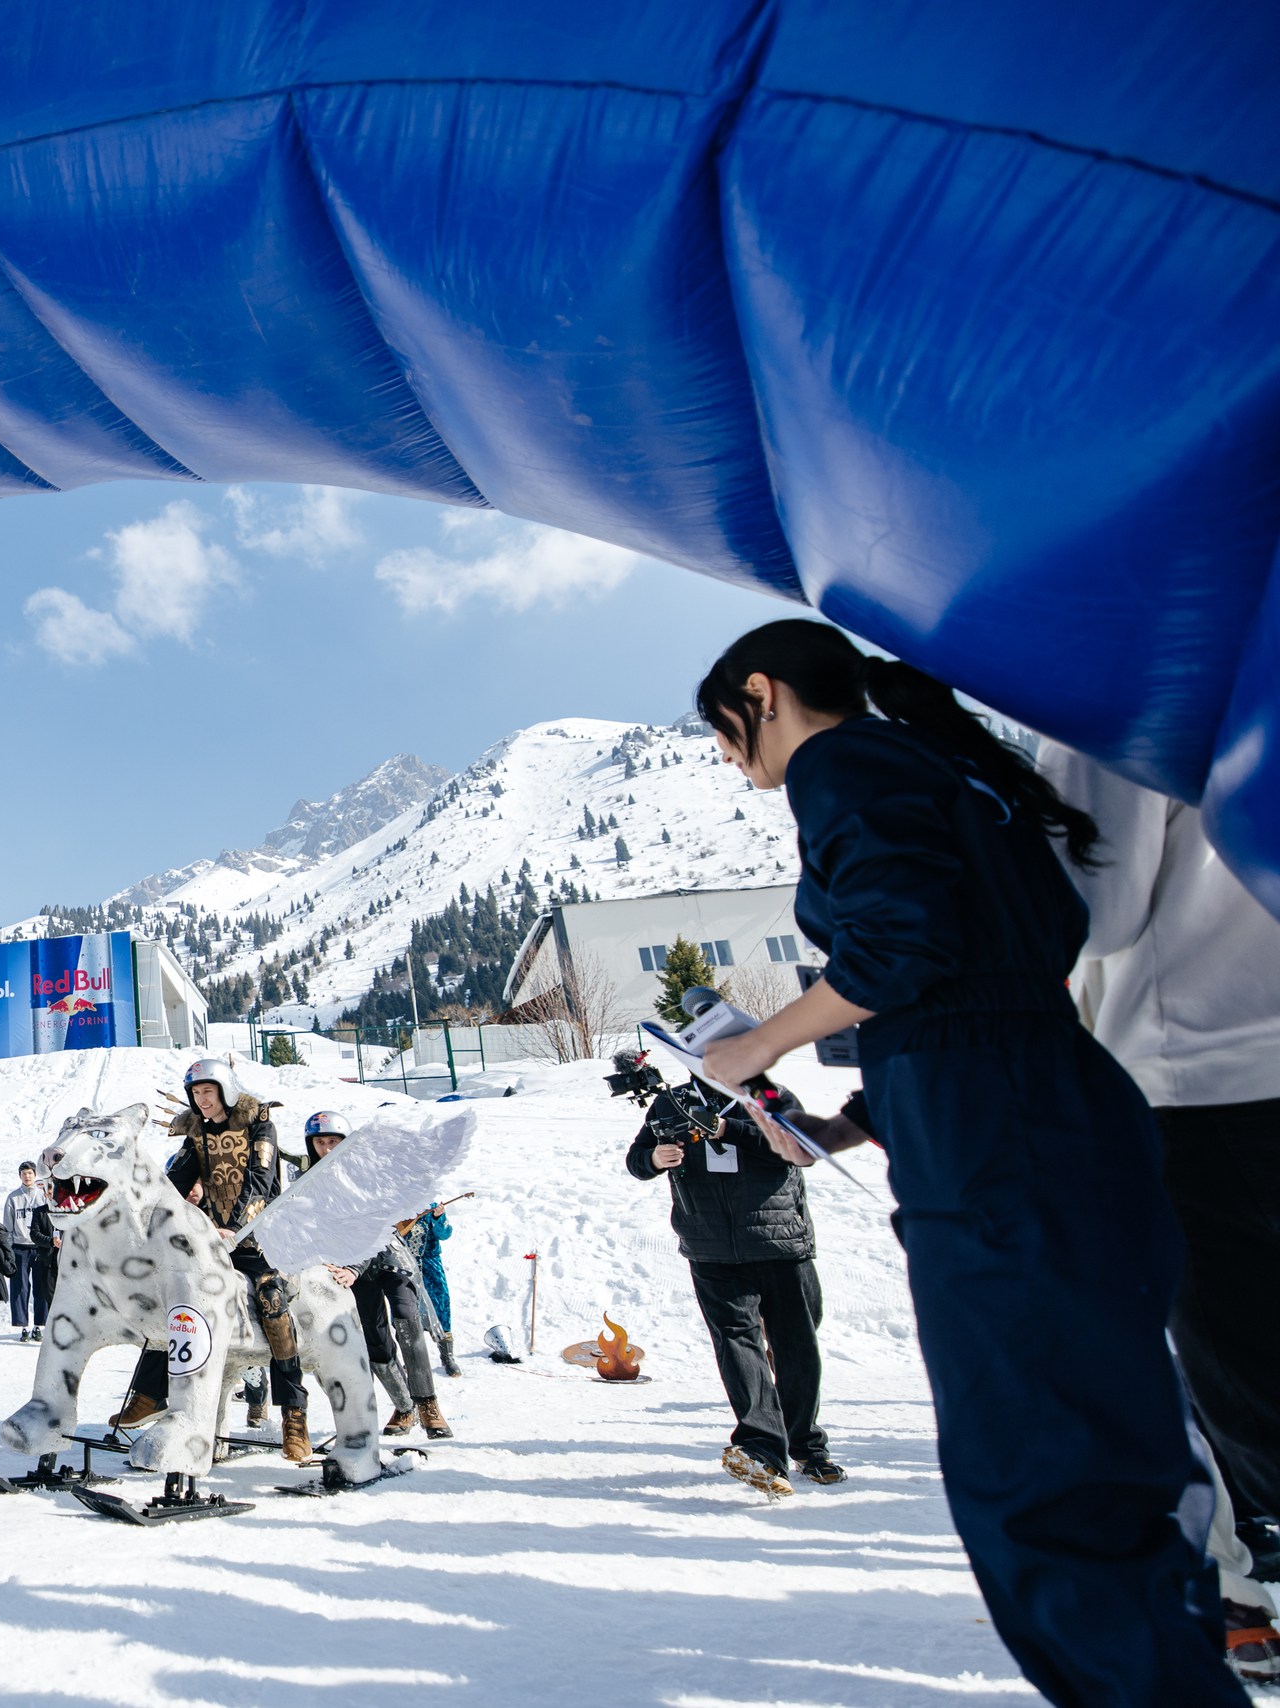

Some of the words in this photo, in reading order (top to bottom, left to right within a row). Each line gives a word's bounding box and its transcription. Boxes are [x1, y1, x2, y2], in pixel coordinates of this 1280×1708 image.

[33, 969, 70, 995] Red
[73, 967, 111, 991] Bull
[170, 1323, 181, 1332] Red
[182, 1324, 197, 1334] Bull
[169, 1338, 192, 1363] 26
